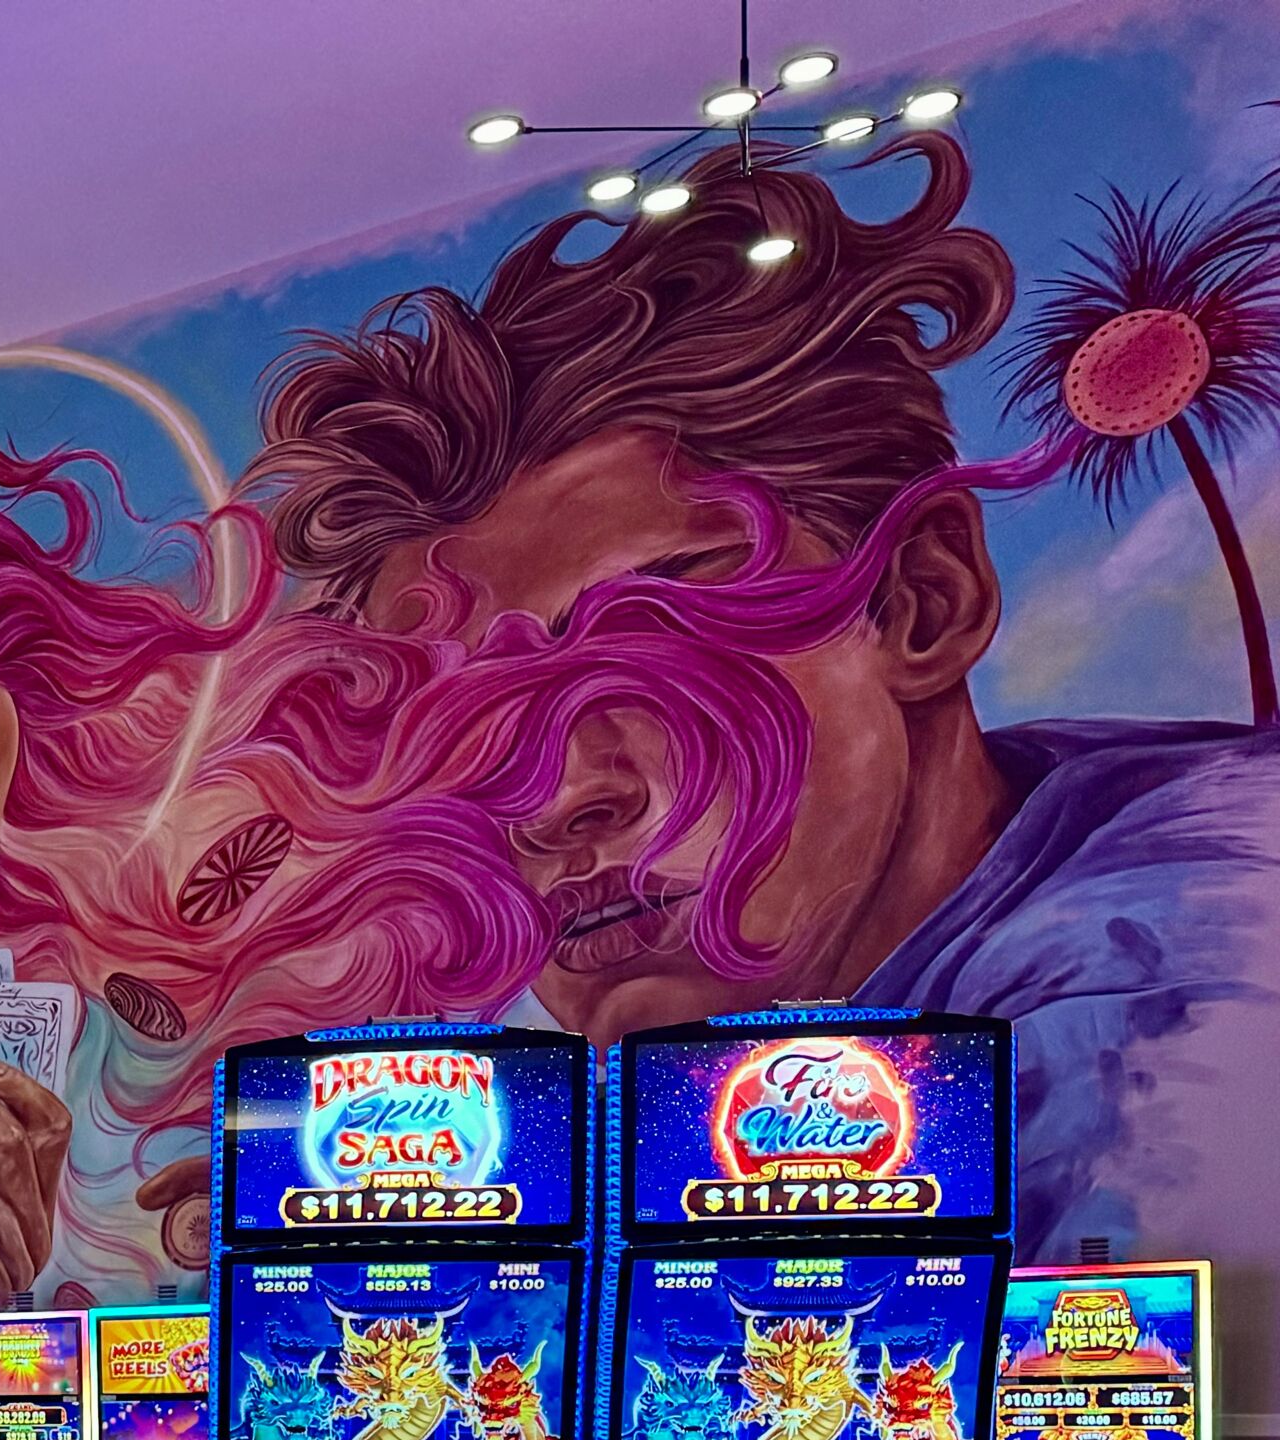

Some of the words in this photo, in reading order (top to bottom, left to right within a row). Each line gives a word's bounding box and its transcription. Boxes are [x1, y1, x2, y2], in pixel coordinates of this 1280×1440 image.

[312, 1053, 495, 1112] DRAGON
[764, 1050, 870, 1102] Fire
[346, 1087, 452, 1133] Spin
[816, 1101, 836, 1120] &
[736, 1105, 886, 1154] Water
[336, 1129, 464, 1168] SAGA
[372, 1172, 432, 1189] MEGA
[781, 1164, 842, 1180] MEGA
[300, 1190, 502, 1221] $11,712.22
[704, 1183, 921, 1214] $11,712.22
[252, 1266, 313, 1279] MINOR
[366, 1264, 431, 1278] MAJOR
[497, 1263, 541, 1276] MINI
[653, 1260, 718, 1274] MINOR
[775, 1258, 844, 1273] MAJOR
[915, 1257, 962, 1271] MINI
[255, 1280, 309, 1293] $25.00
[366, 1279, 432, 1292] $559.13
[489, 1277, 546, 1291] $10.00
[655, 1276, 713, 1289] $25.00
[773, 1275, 843, 1288] $927.33
[905, 1273, 966, 1287] $10.00
[1052, 1309, 1132, 1328] FORTUNE
[112, 1341, 163, 1358] MORE
[1045, 1326, 1140, 1354] FRENZY
[112, 1360, 167, 1376] REELS
